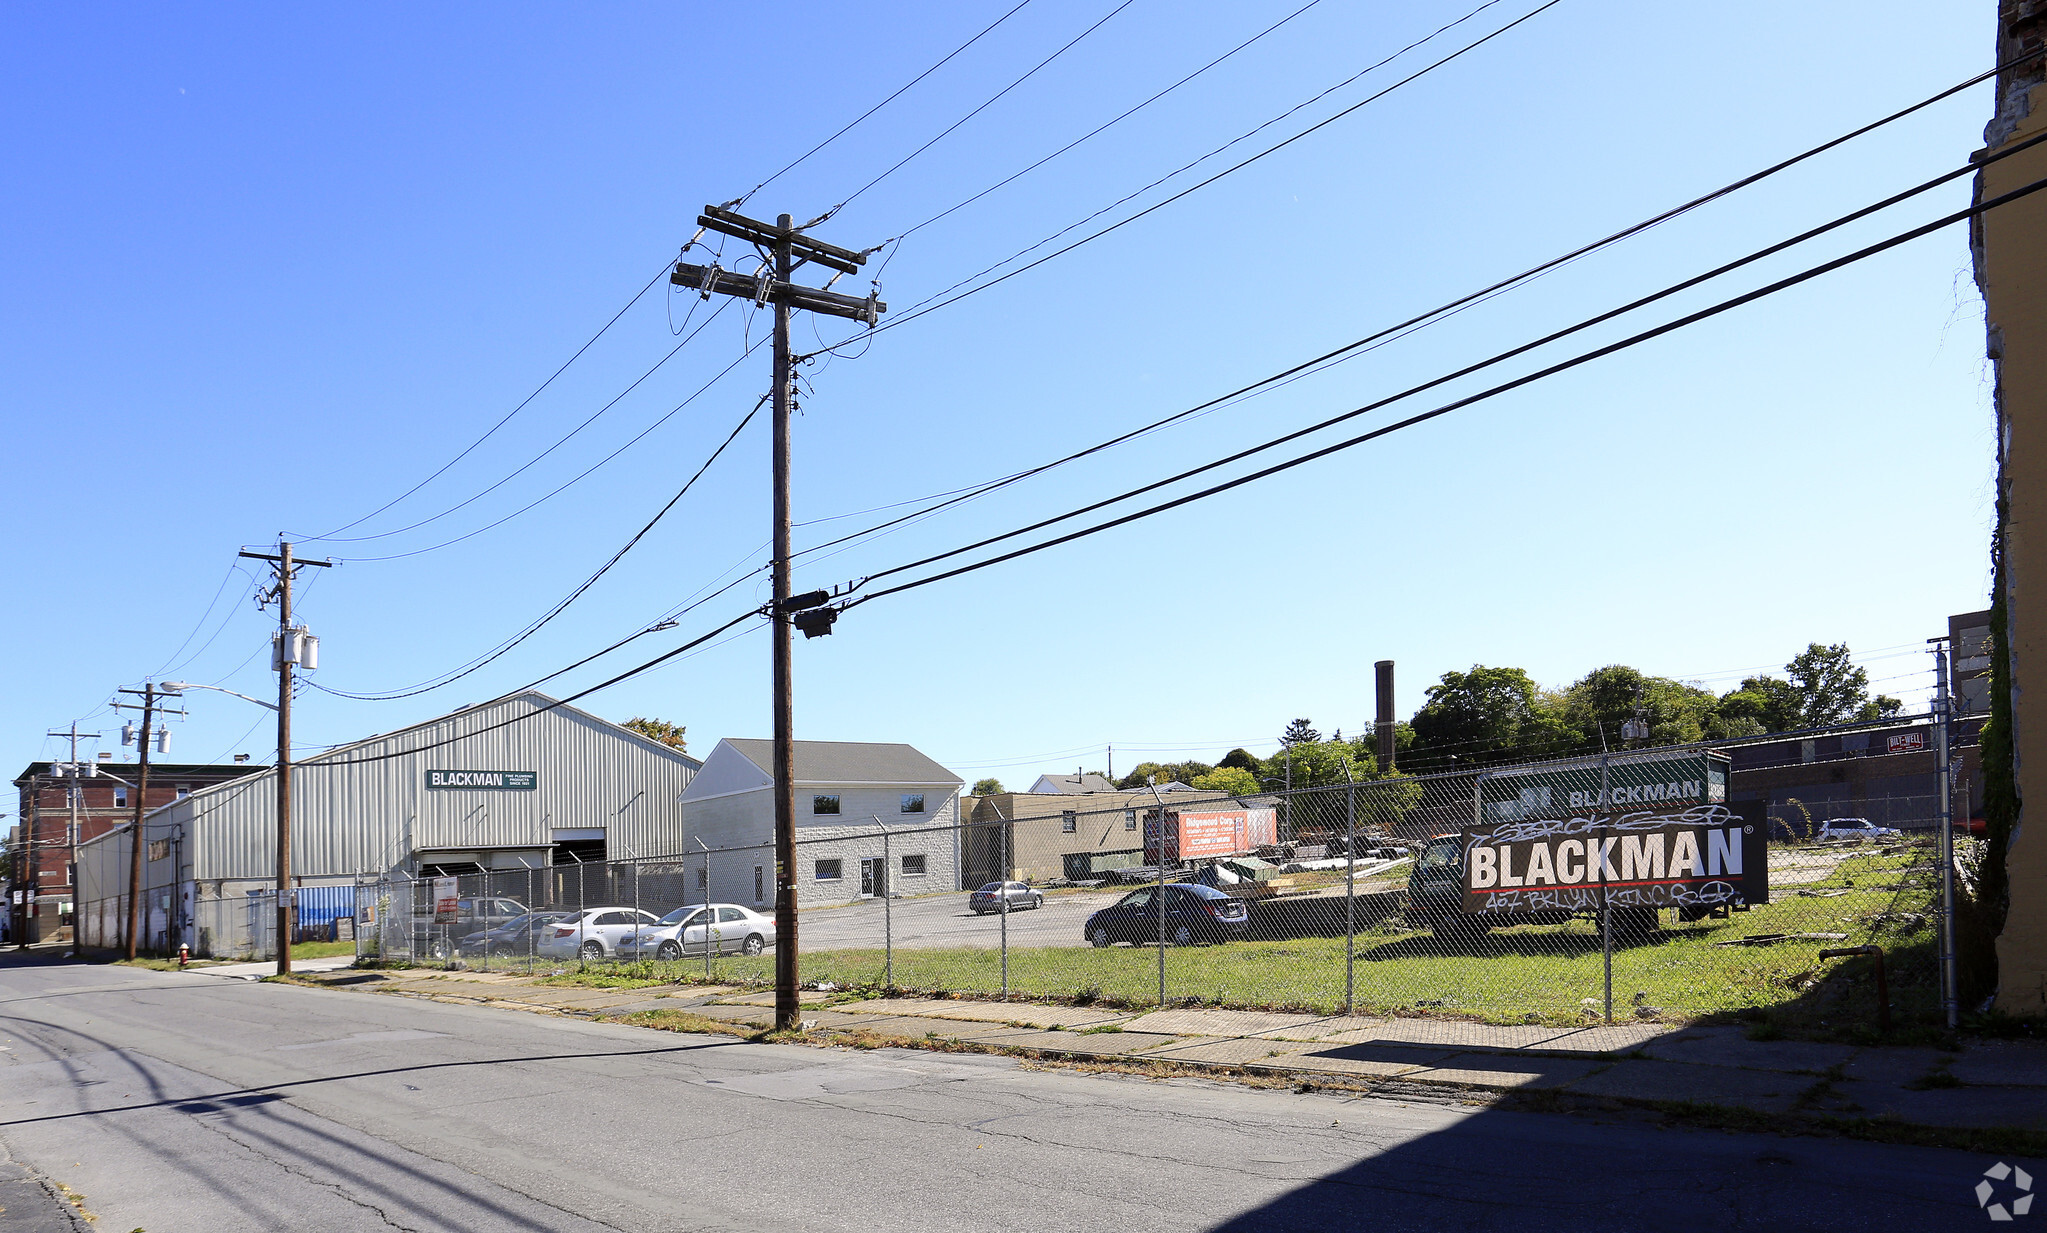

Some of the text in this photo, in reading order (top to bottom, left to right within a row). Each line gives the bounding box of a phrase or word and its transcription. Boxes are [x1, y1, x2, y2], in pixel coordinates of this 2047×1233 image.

[432, 772, 503, 786] BLACKMAN
[1570, 780, 1700, 808] BLACKMAN
[1471, 827, 1743, 889] BLACKMAN
